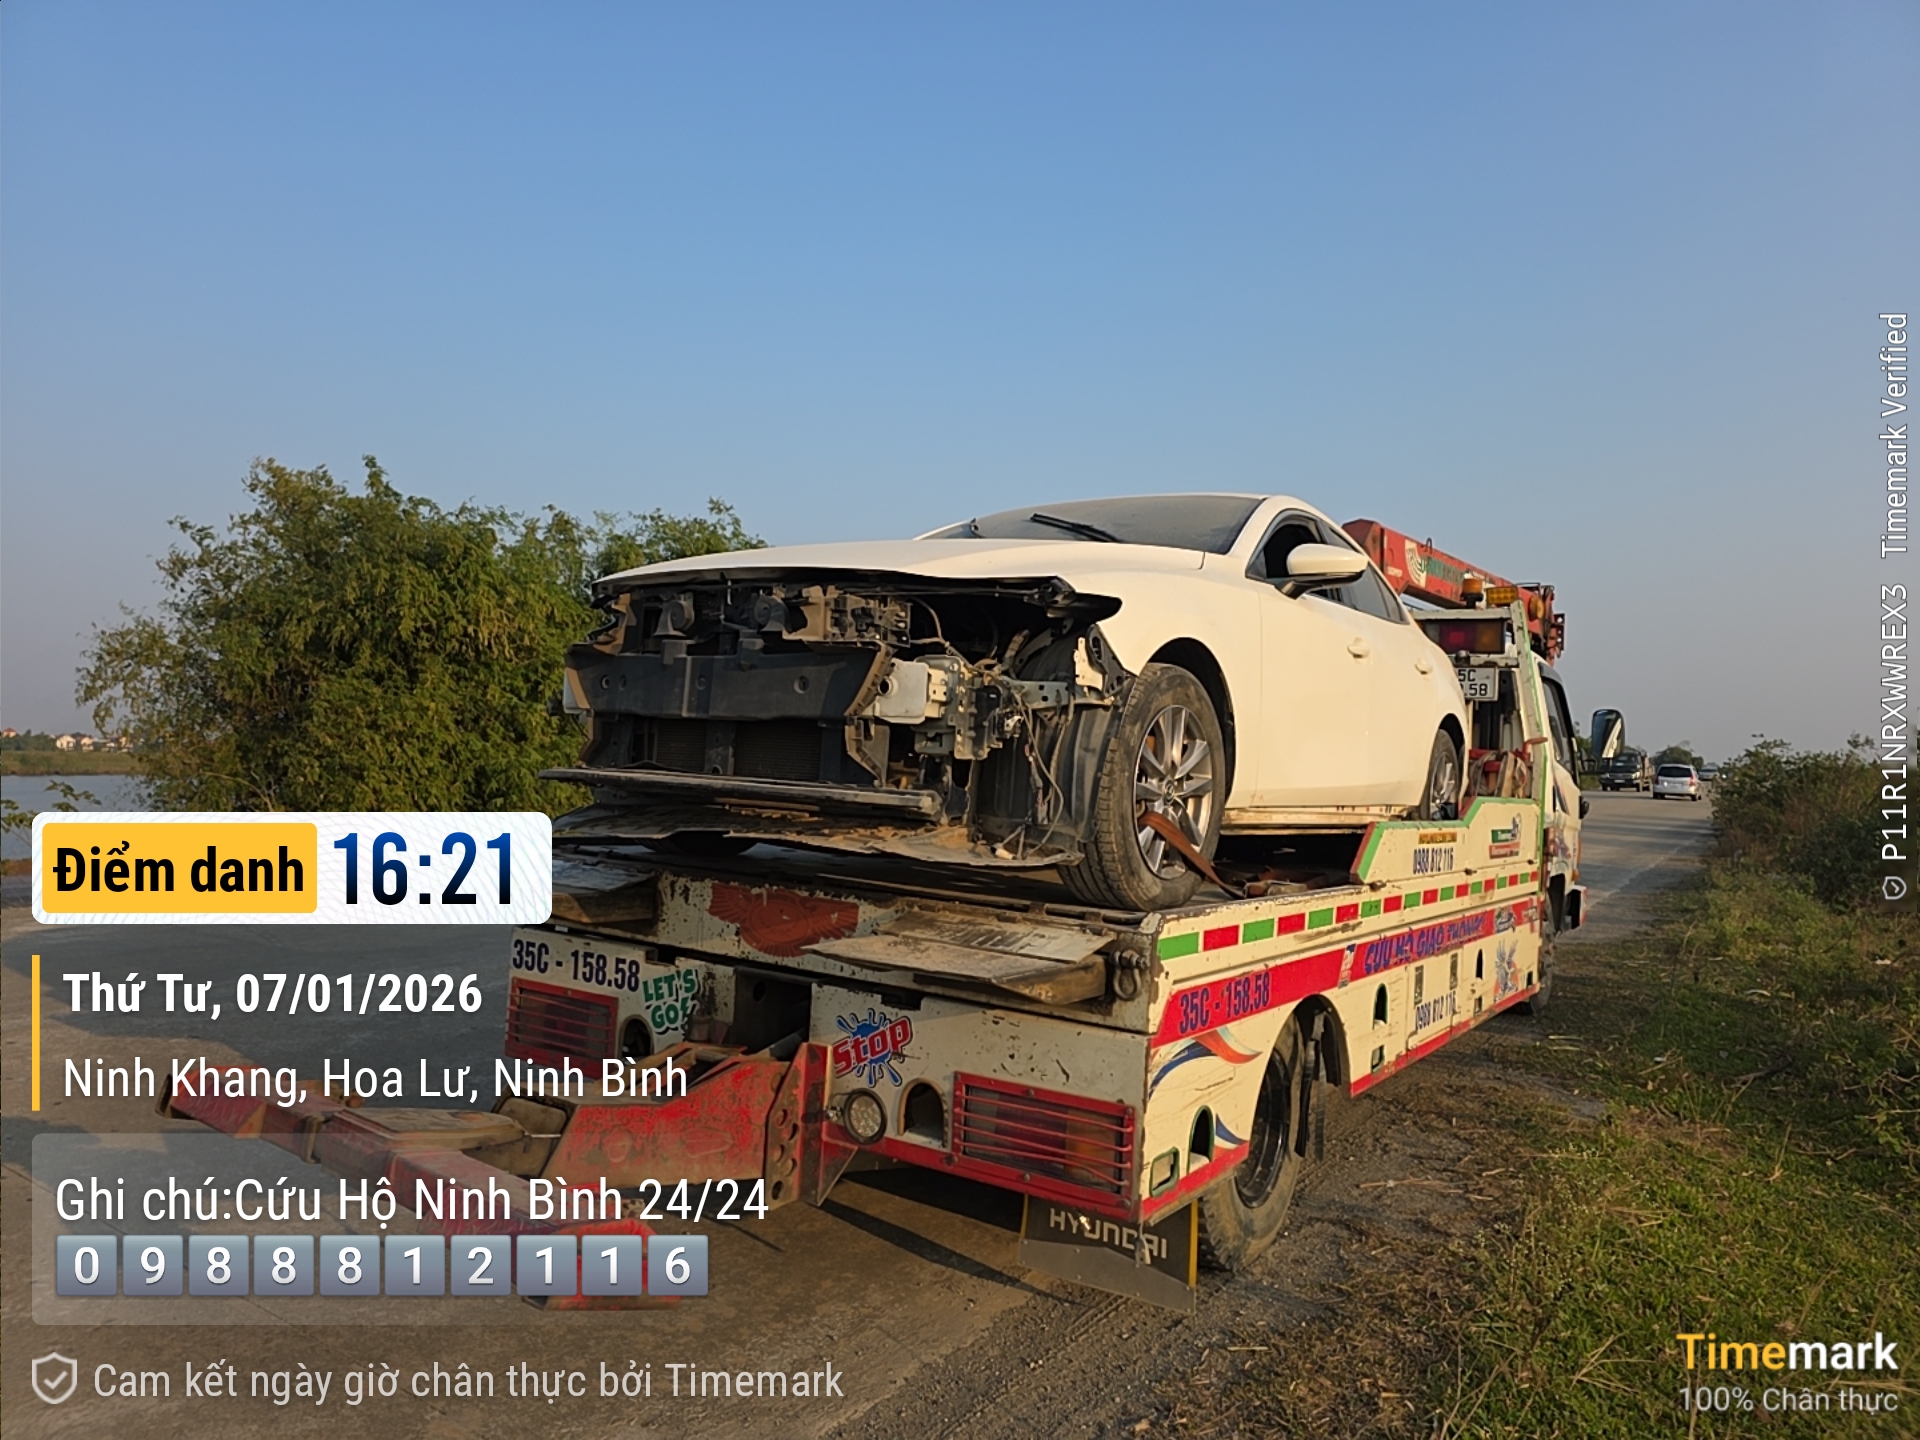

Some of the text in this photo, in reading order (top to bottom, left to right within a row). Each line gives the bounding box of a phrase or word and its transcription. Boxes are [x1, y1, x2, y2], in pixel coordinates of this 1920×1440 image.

[1457, 668, 1476, 682] 5C
[512, 938, 550, 974] 35C
[571, 949, 641, 992] 158.58
[642, 968, 697, 1003] LET'S
[1179, 987, 1210, 1034] 35C
[1226, 971, 1270, 1019] 158.58
[1050, 1207, 1167, 1260] HYUNDAI
